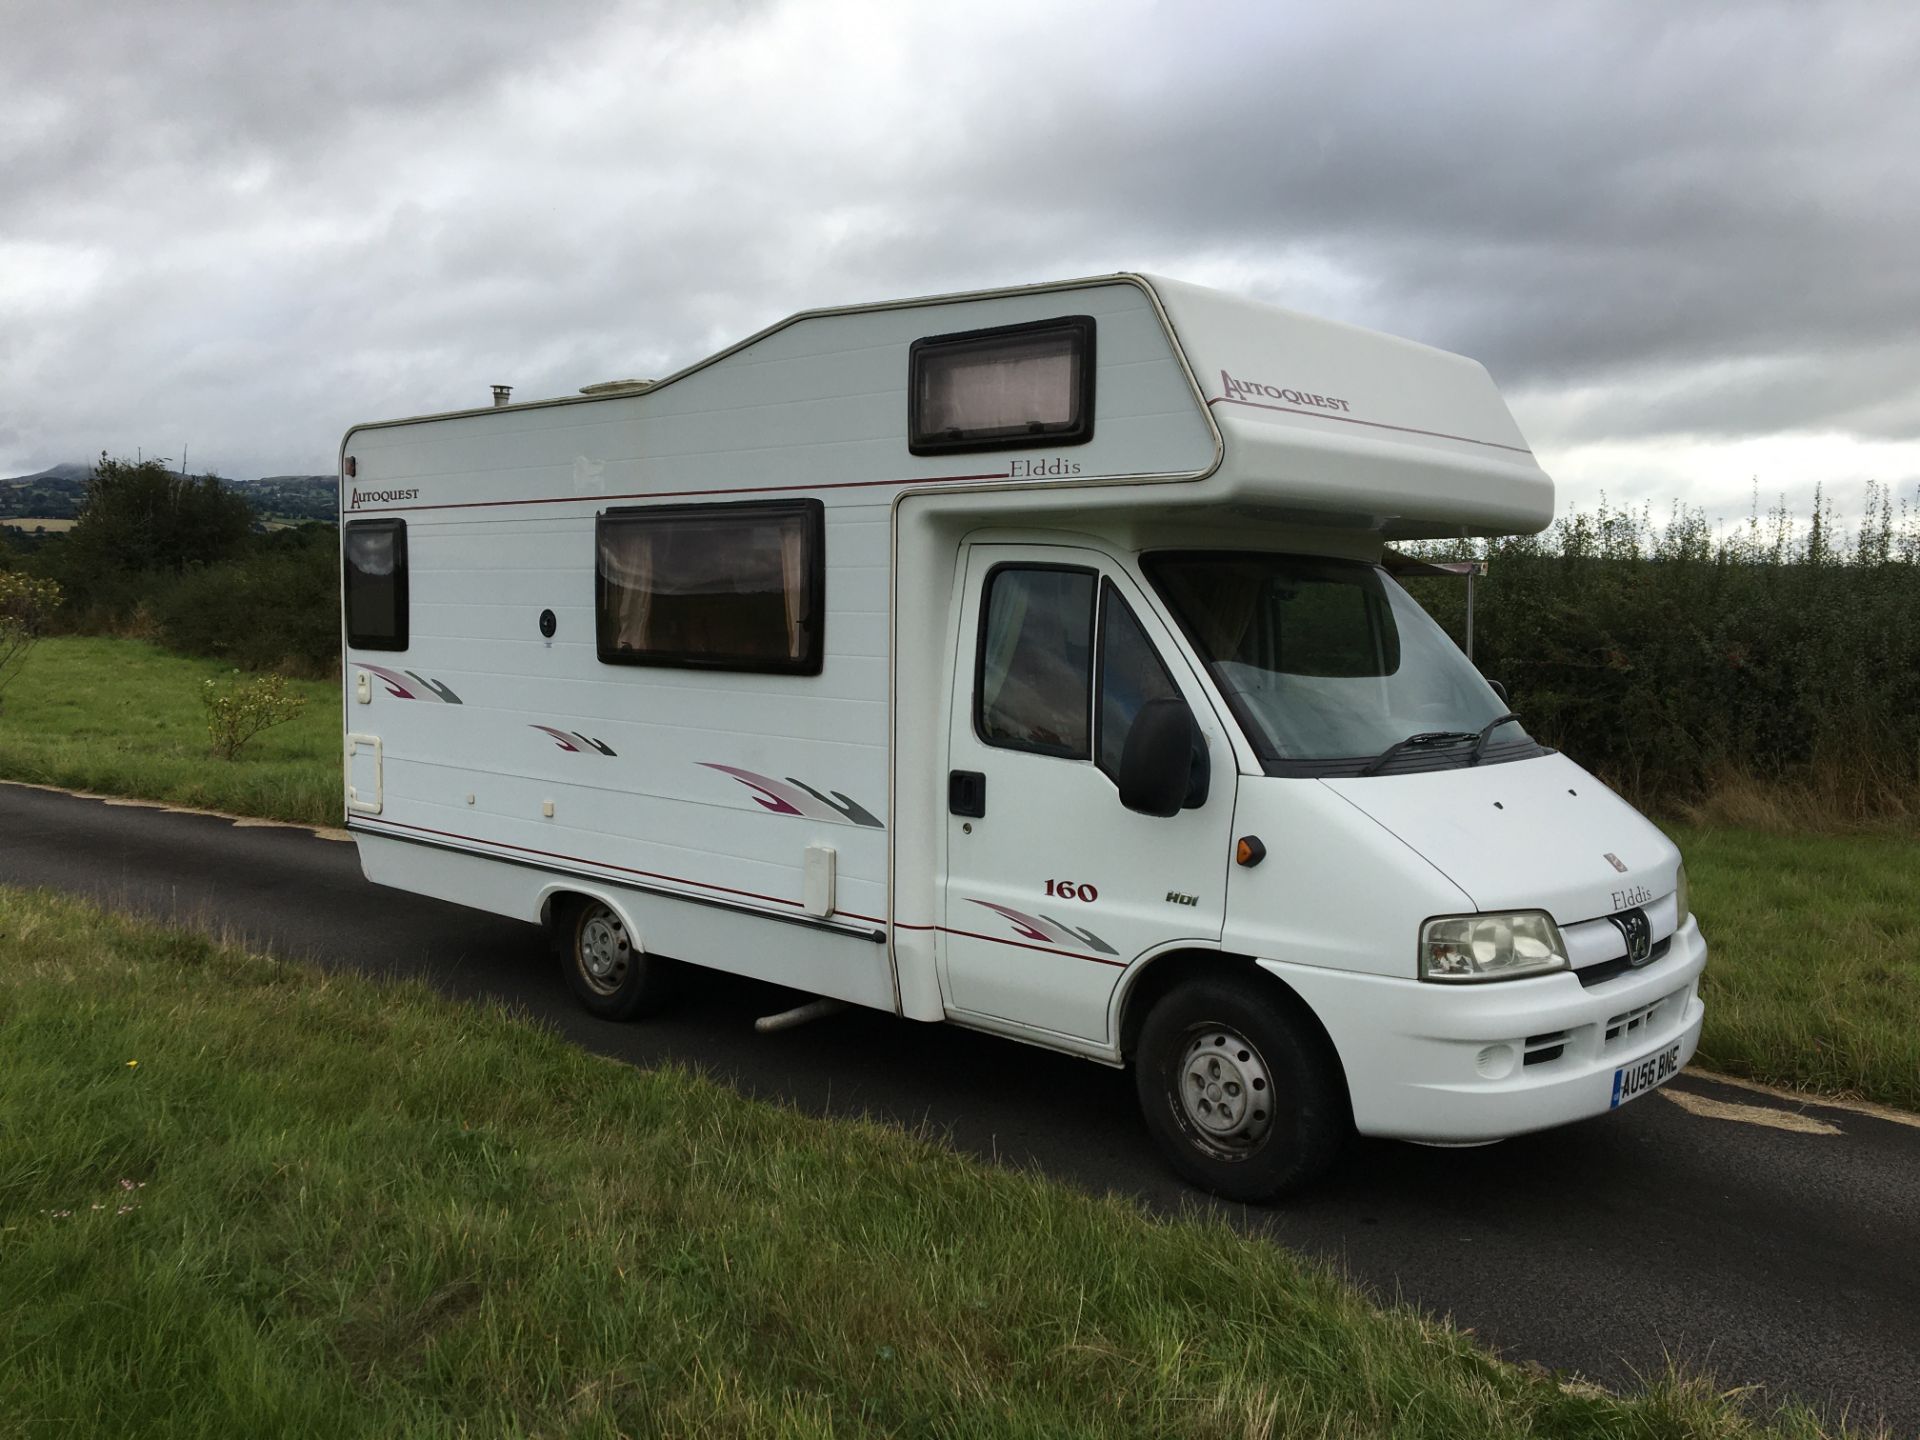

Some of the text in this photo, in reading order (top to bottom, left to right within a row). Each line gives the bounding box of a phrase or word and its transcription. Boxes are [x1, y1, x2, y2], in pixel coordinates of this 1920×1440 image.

[1220, 369, 1350, 412] AUTOQUEST
[1010, 457, 1081, 477] Elddis
[350, 488, 419, 509] AUTOQUEST
[1044, 879, 1098, 903] 160
[1611, 885, 1652, 911] Elddis
[1621, 1044, 1680, 1098] AU56 BNE
